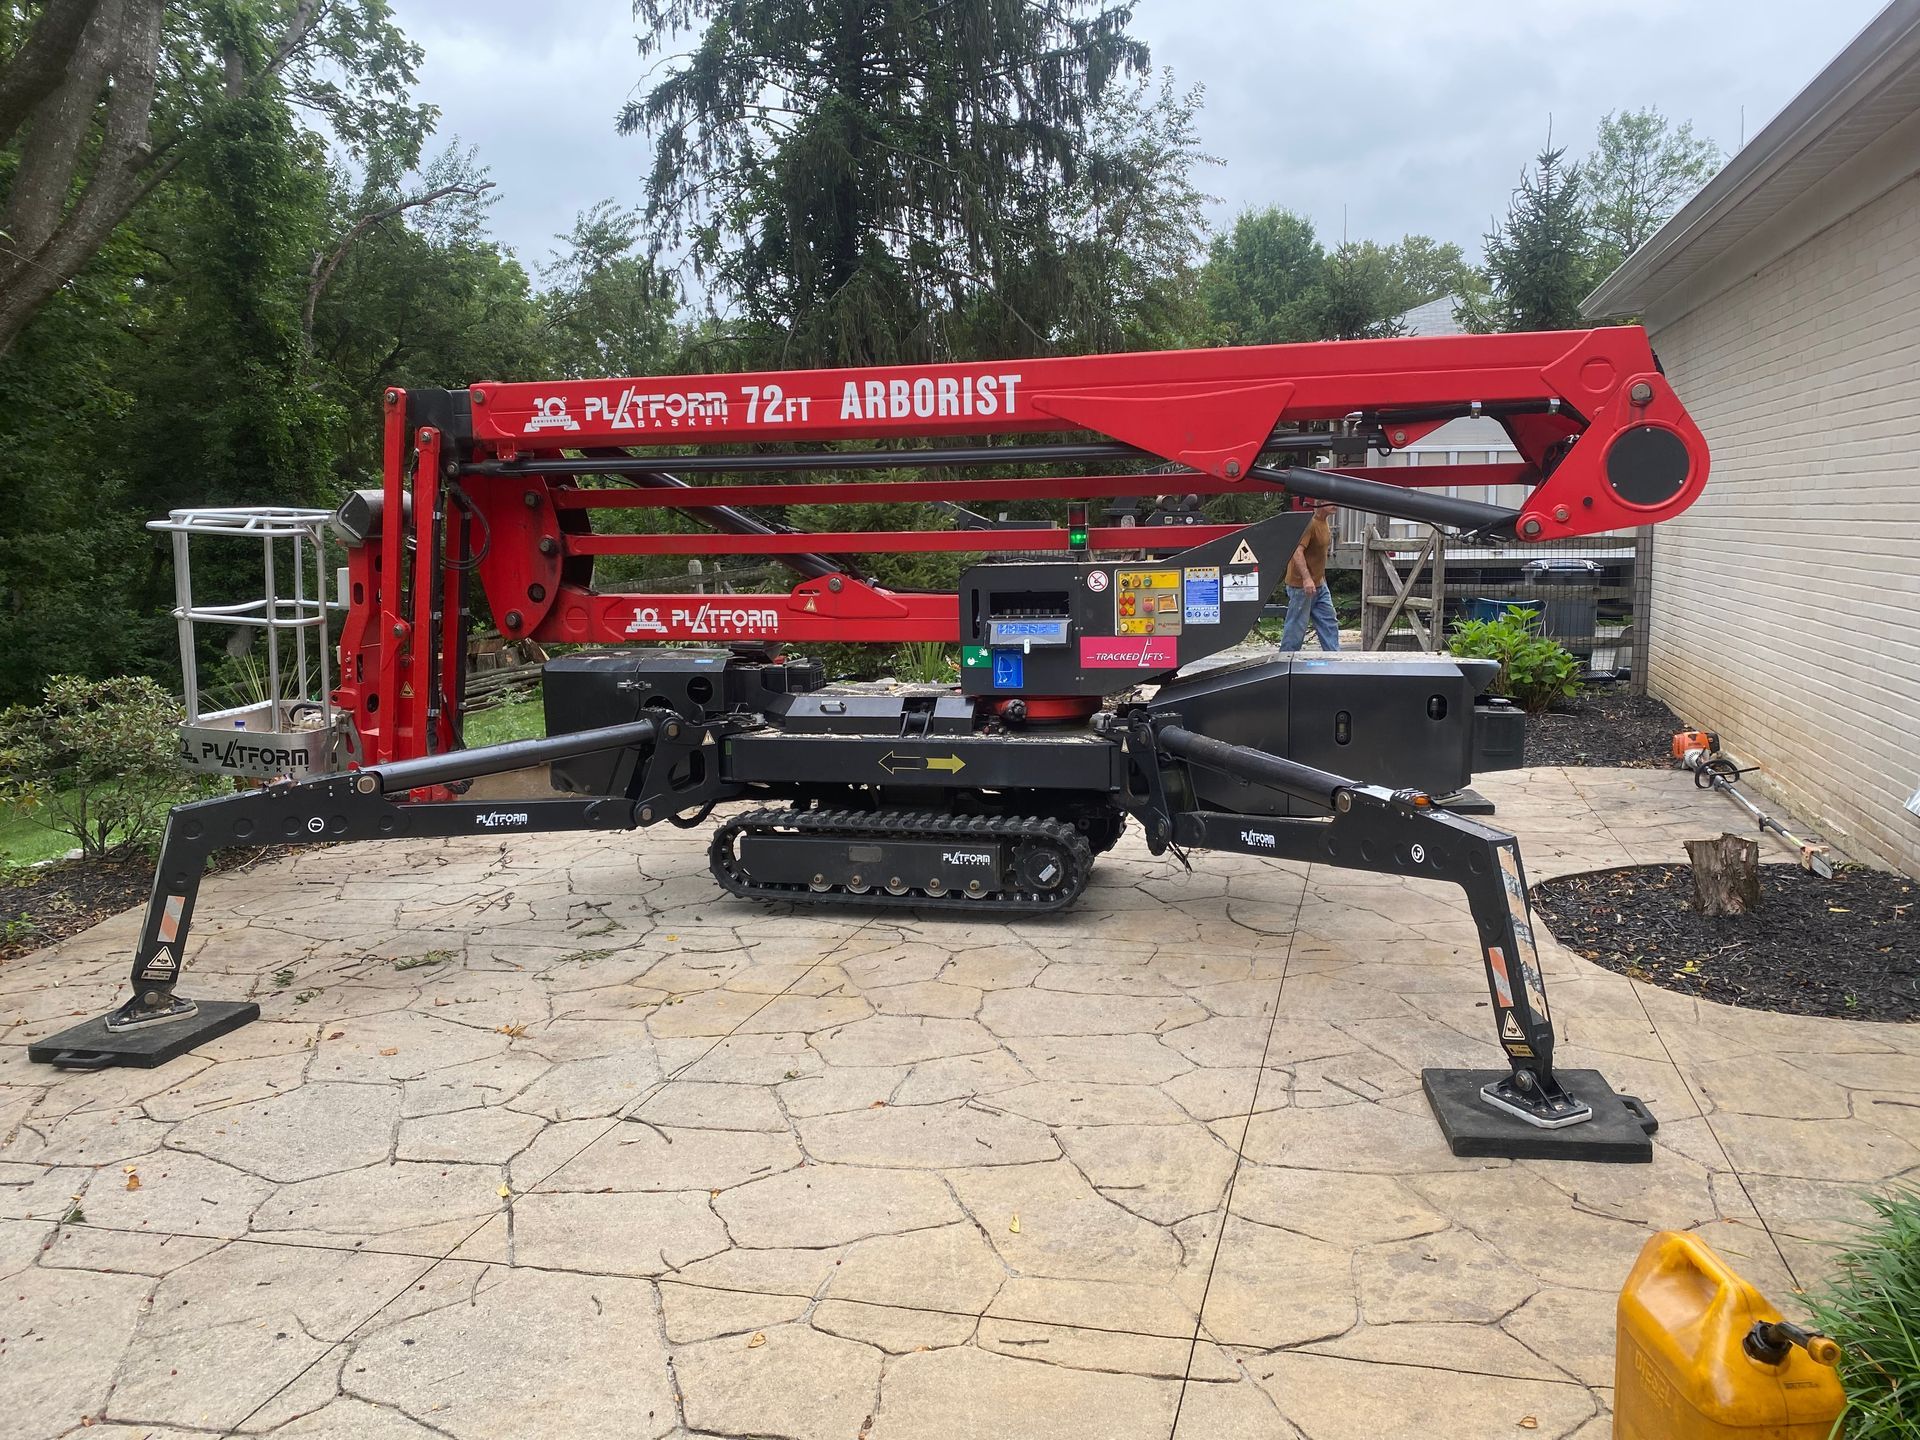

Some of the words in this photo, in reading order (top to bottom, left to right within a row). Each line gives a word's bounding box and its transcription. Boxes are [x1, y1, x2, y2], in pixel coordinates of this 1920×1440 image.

[584, 386, 728, 429] PLATFORM
[840, 374, 1022, 420] ARBORIST
[637, 417, 728, 428] BASKET
[672, 602, 778, 634] PLATFORM
[1096, 652, 1139, 661] TRACKED
[202, 739, 309, 768] PLATFORM
[476, 811, 528, 826] PLATFORM
[1240, 828, 1276, 846] PLATFORM
[943, 850, 990, 864] PLATFORM
